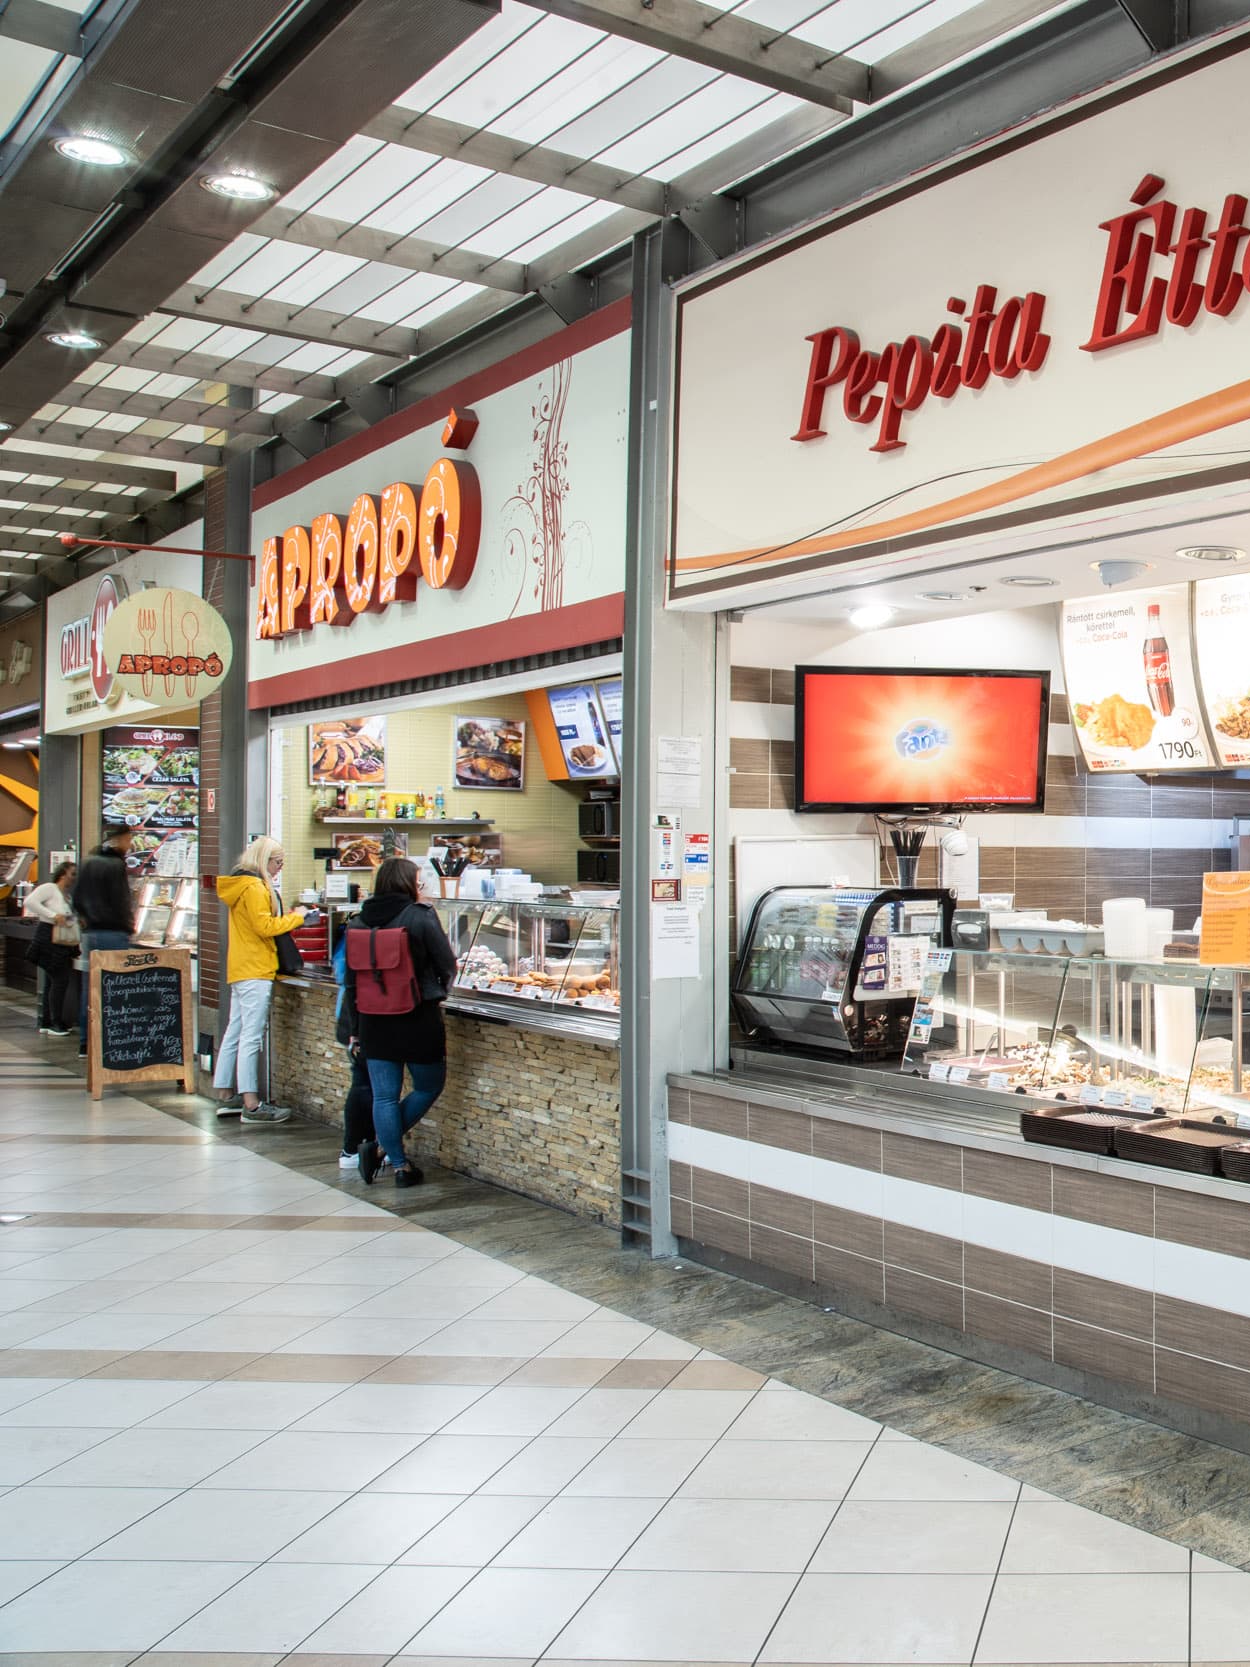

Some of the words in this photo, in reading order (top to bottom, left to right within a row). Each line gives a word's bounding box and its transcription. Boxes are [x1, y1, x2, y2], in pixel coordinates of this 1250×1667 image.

[791, 285, 1051, 453] Pepita
[255, 407, 482, 640] APROPÓ
[60, 616, 91, 678] GRILL
[117, 652, 224, 677] APROPÓ
